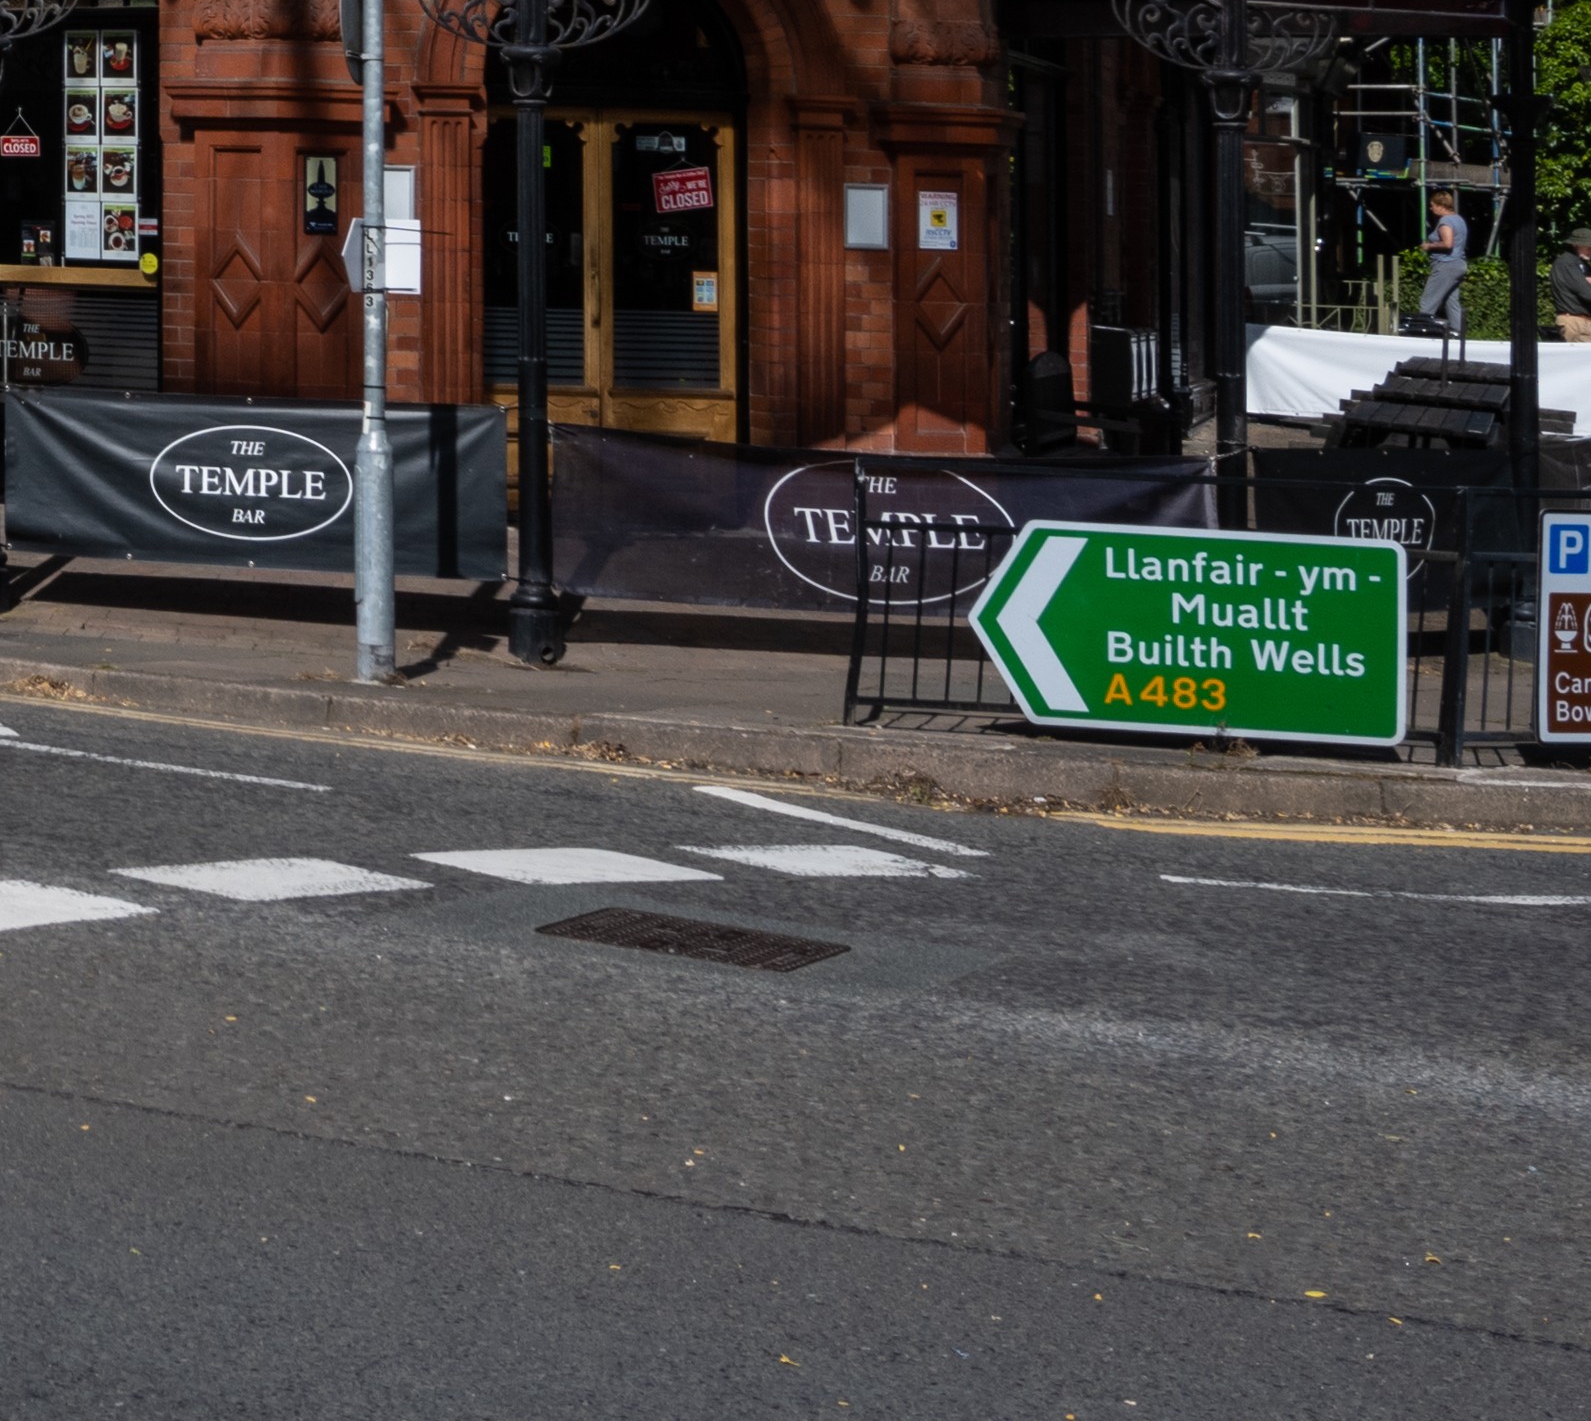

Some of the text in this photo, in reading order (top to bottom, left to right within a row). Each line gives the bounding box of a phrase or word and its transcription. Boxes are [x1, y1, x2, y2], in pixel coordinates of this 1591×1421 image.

[3, 143, 36, 154] CLOSED
[661, 190, 709, 209] CLOSED
[643, 235, 689, 247] TEMPLE
[22, 324, 40, 334] THE
[22, 367, 42, 377] BAR
[231, 440, 266, 456] THE
[175, 464, 327, 500] TEMPLE
[1376, 492, 1395, 506] THE
[232, 508, 265, 525] BAR
[793, 507, 986, 550] TEMPLE
[1346, 518, 1425, 544] TEMPLE
[870, 564, 911, 585] BAR
[1106, 546, 1264, 587] Llanfair
[1298, 564, 1358, 596] ym
[1171, 592, 1310, 632] Muallt
[1107, 630, 1366, 678] Builth Wells
